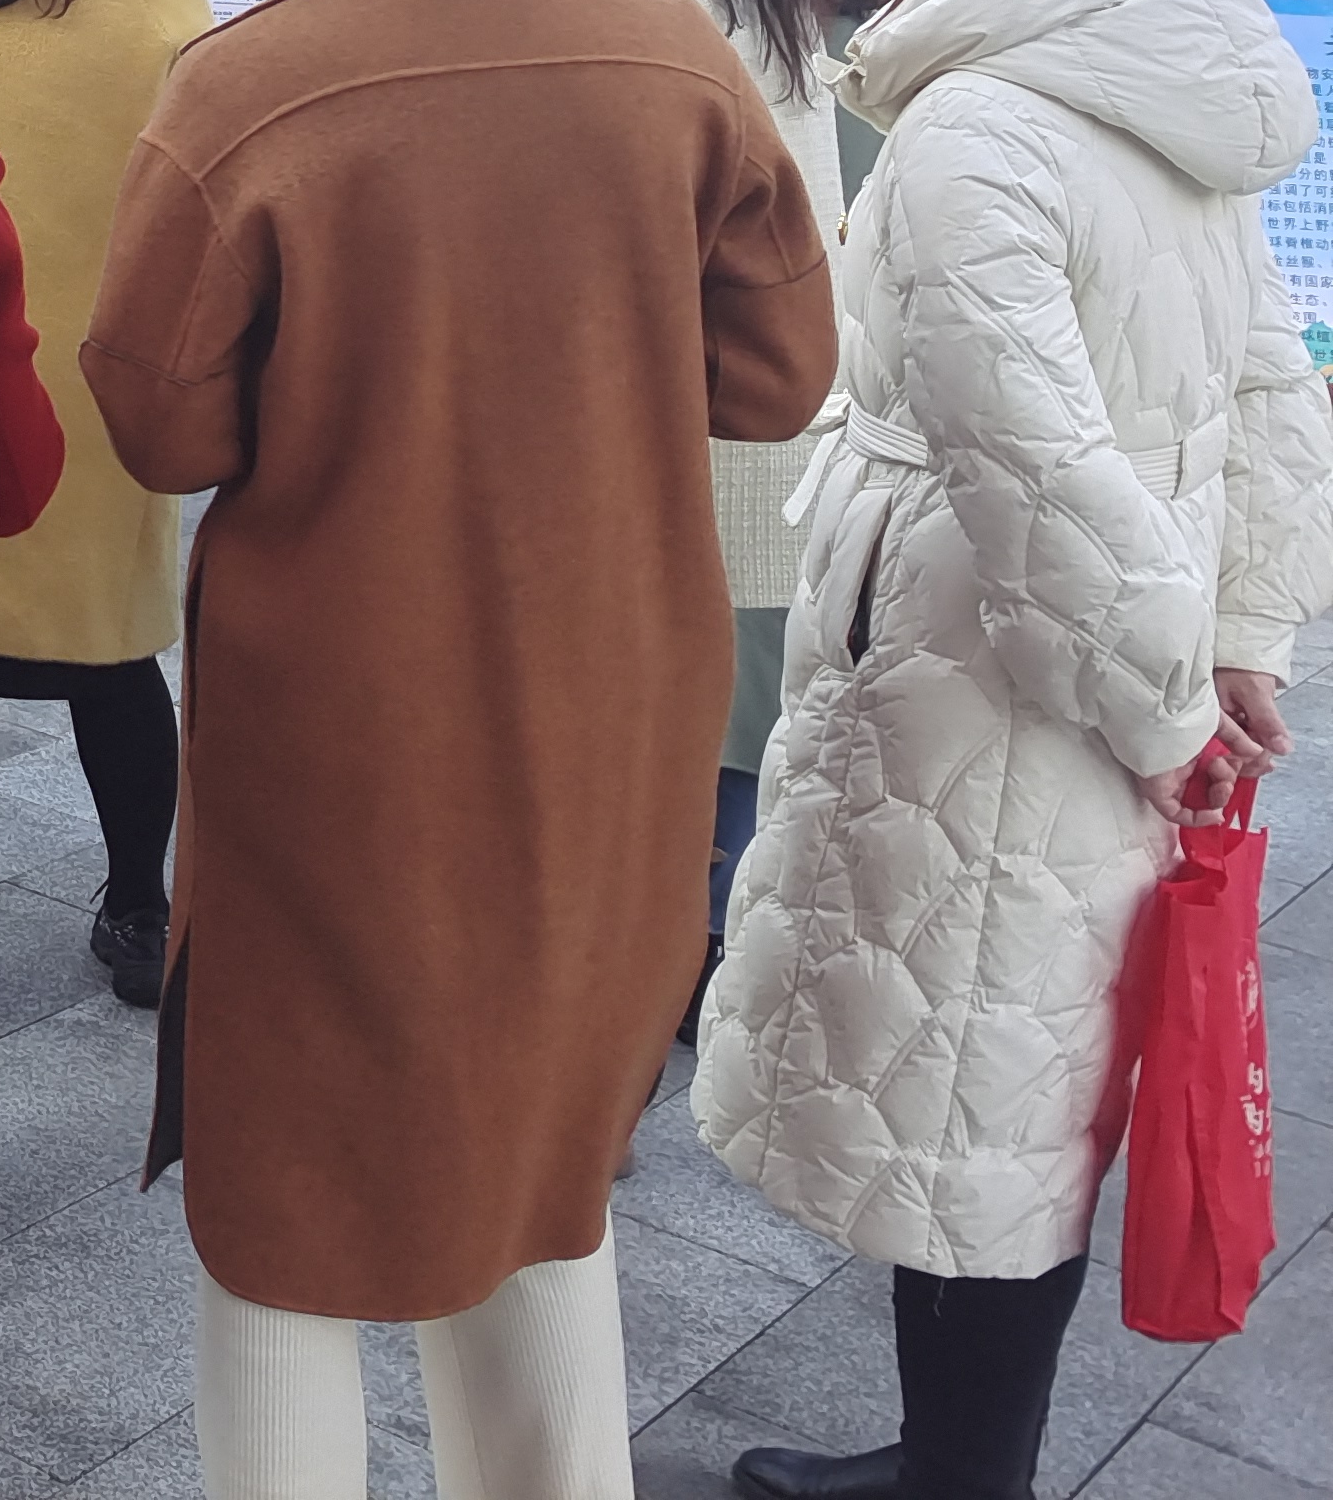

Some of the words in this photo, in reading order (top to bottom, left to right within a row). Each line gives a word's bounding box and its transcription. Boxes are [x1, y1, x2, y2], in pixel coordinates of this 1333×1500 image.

[1288, 167, 1333, 182] 分的
[1260, 198, 1333, 213] 标包括消
[1268, 216, 1333, 232] 世界上野
[1269, 235, 1333, 251] 球脊椎动
